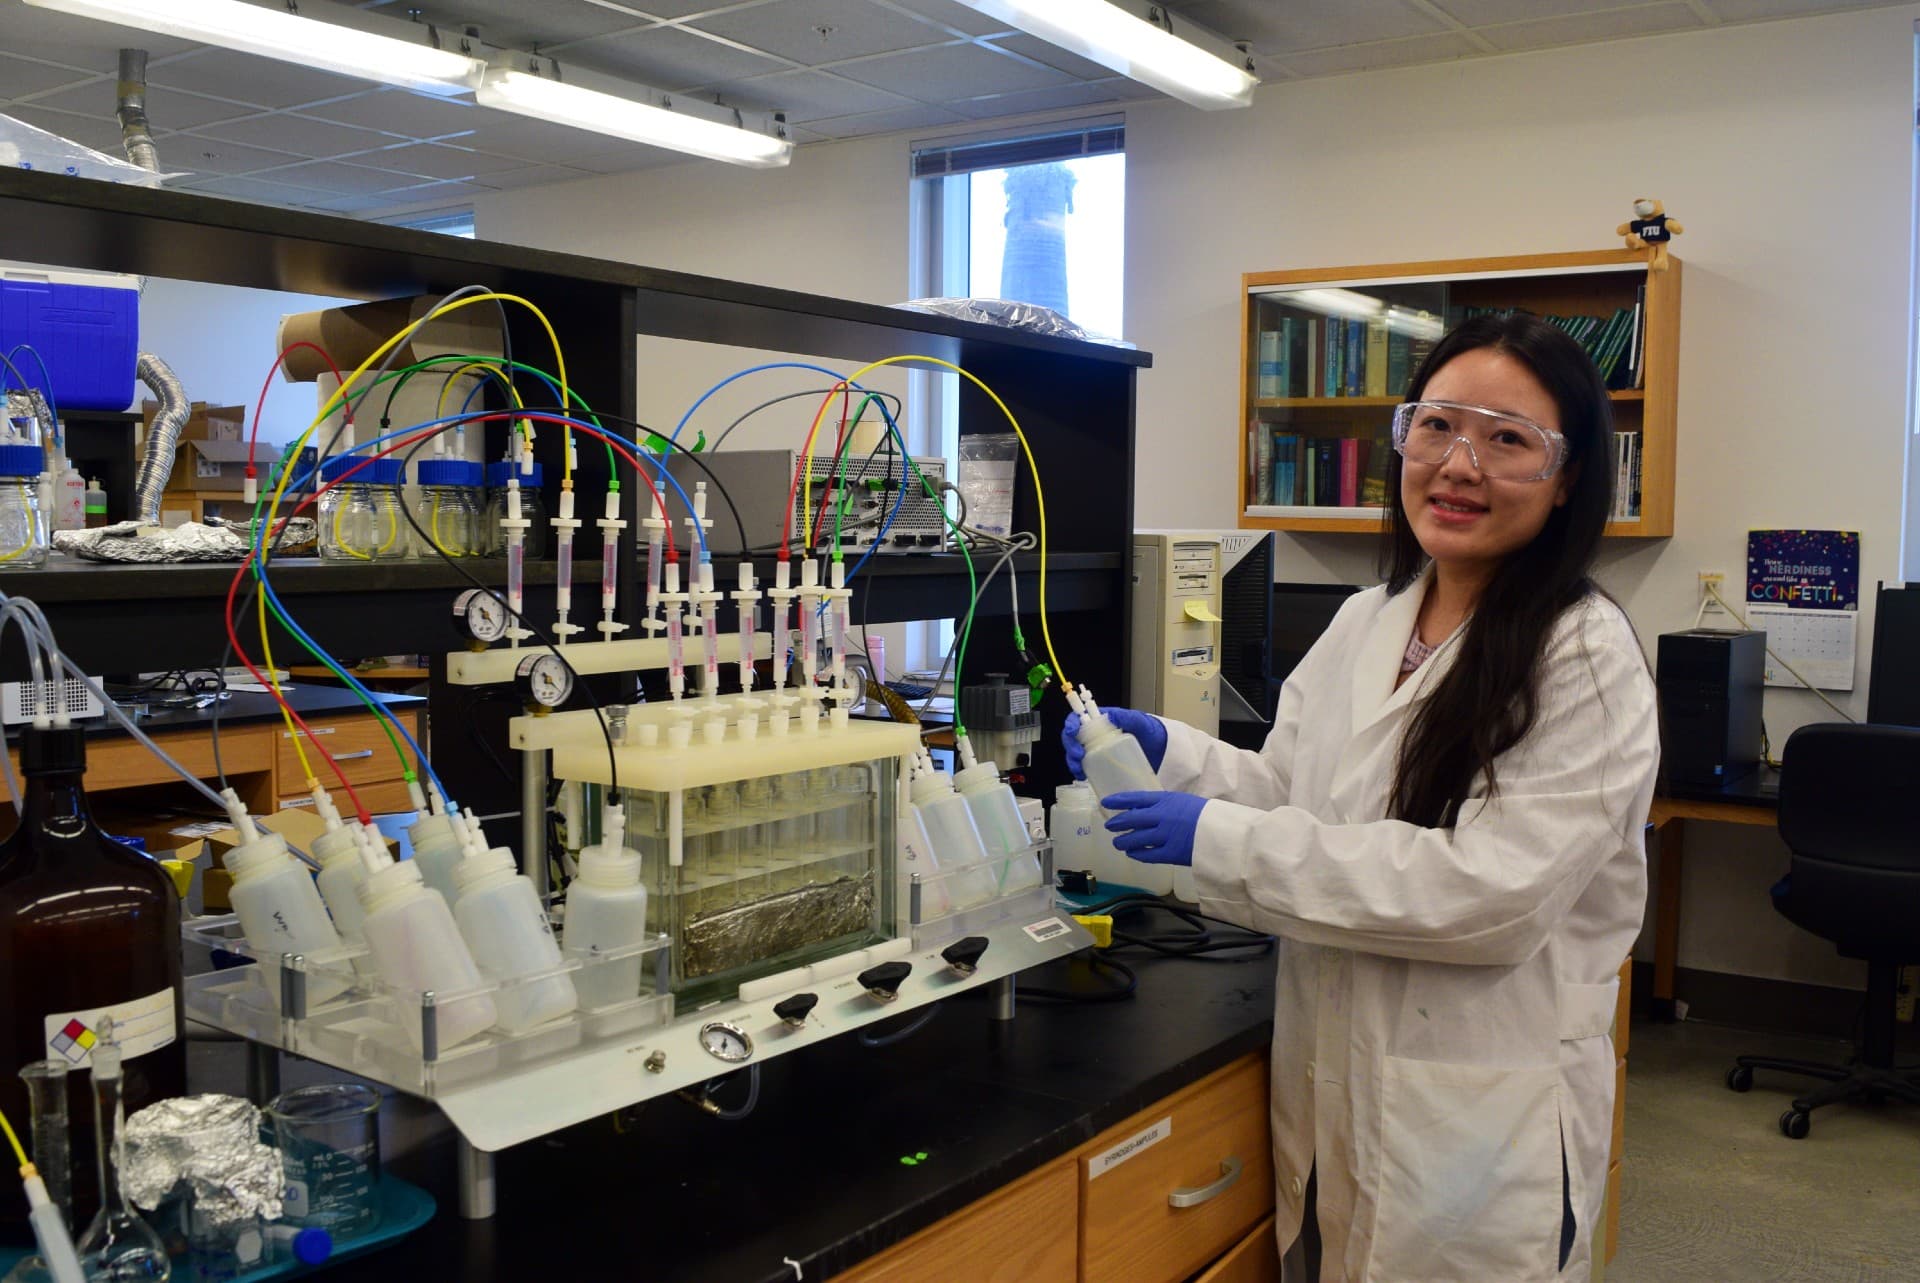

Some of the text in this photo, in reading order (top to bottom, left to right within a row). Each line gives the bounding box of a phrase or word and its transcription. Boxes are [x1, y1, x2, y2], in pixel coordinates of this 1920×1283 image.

[1642, 226, 1660, 237] FIU
[1769, 564, 1832, 576] NERDINESS
[1751, 584, 1837, 602] CONFETTI
